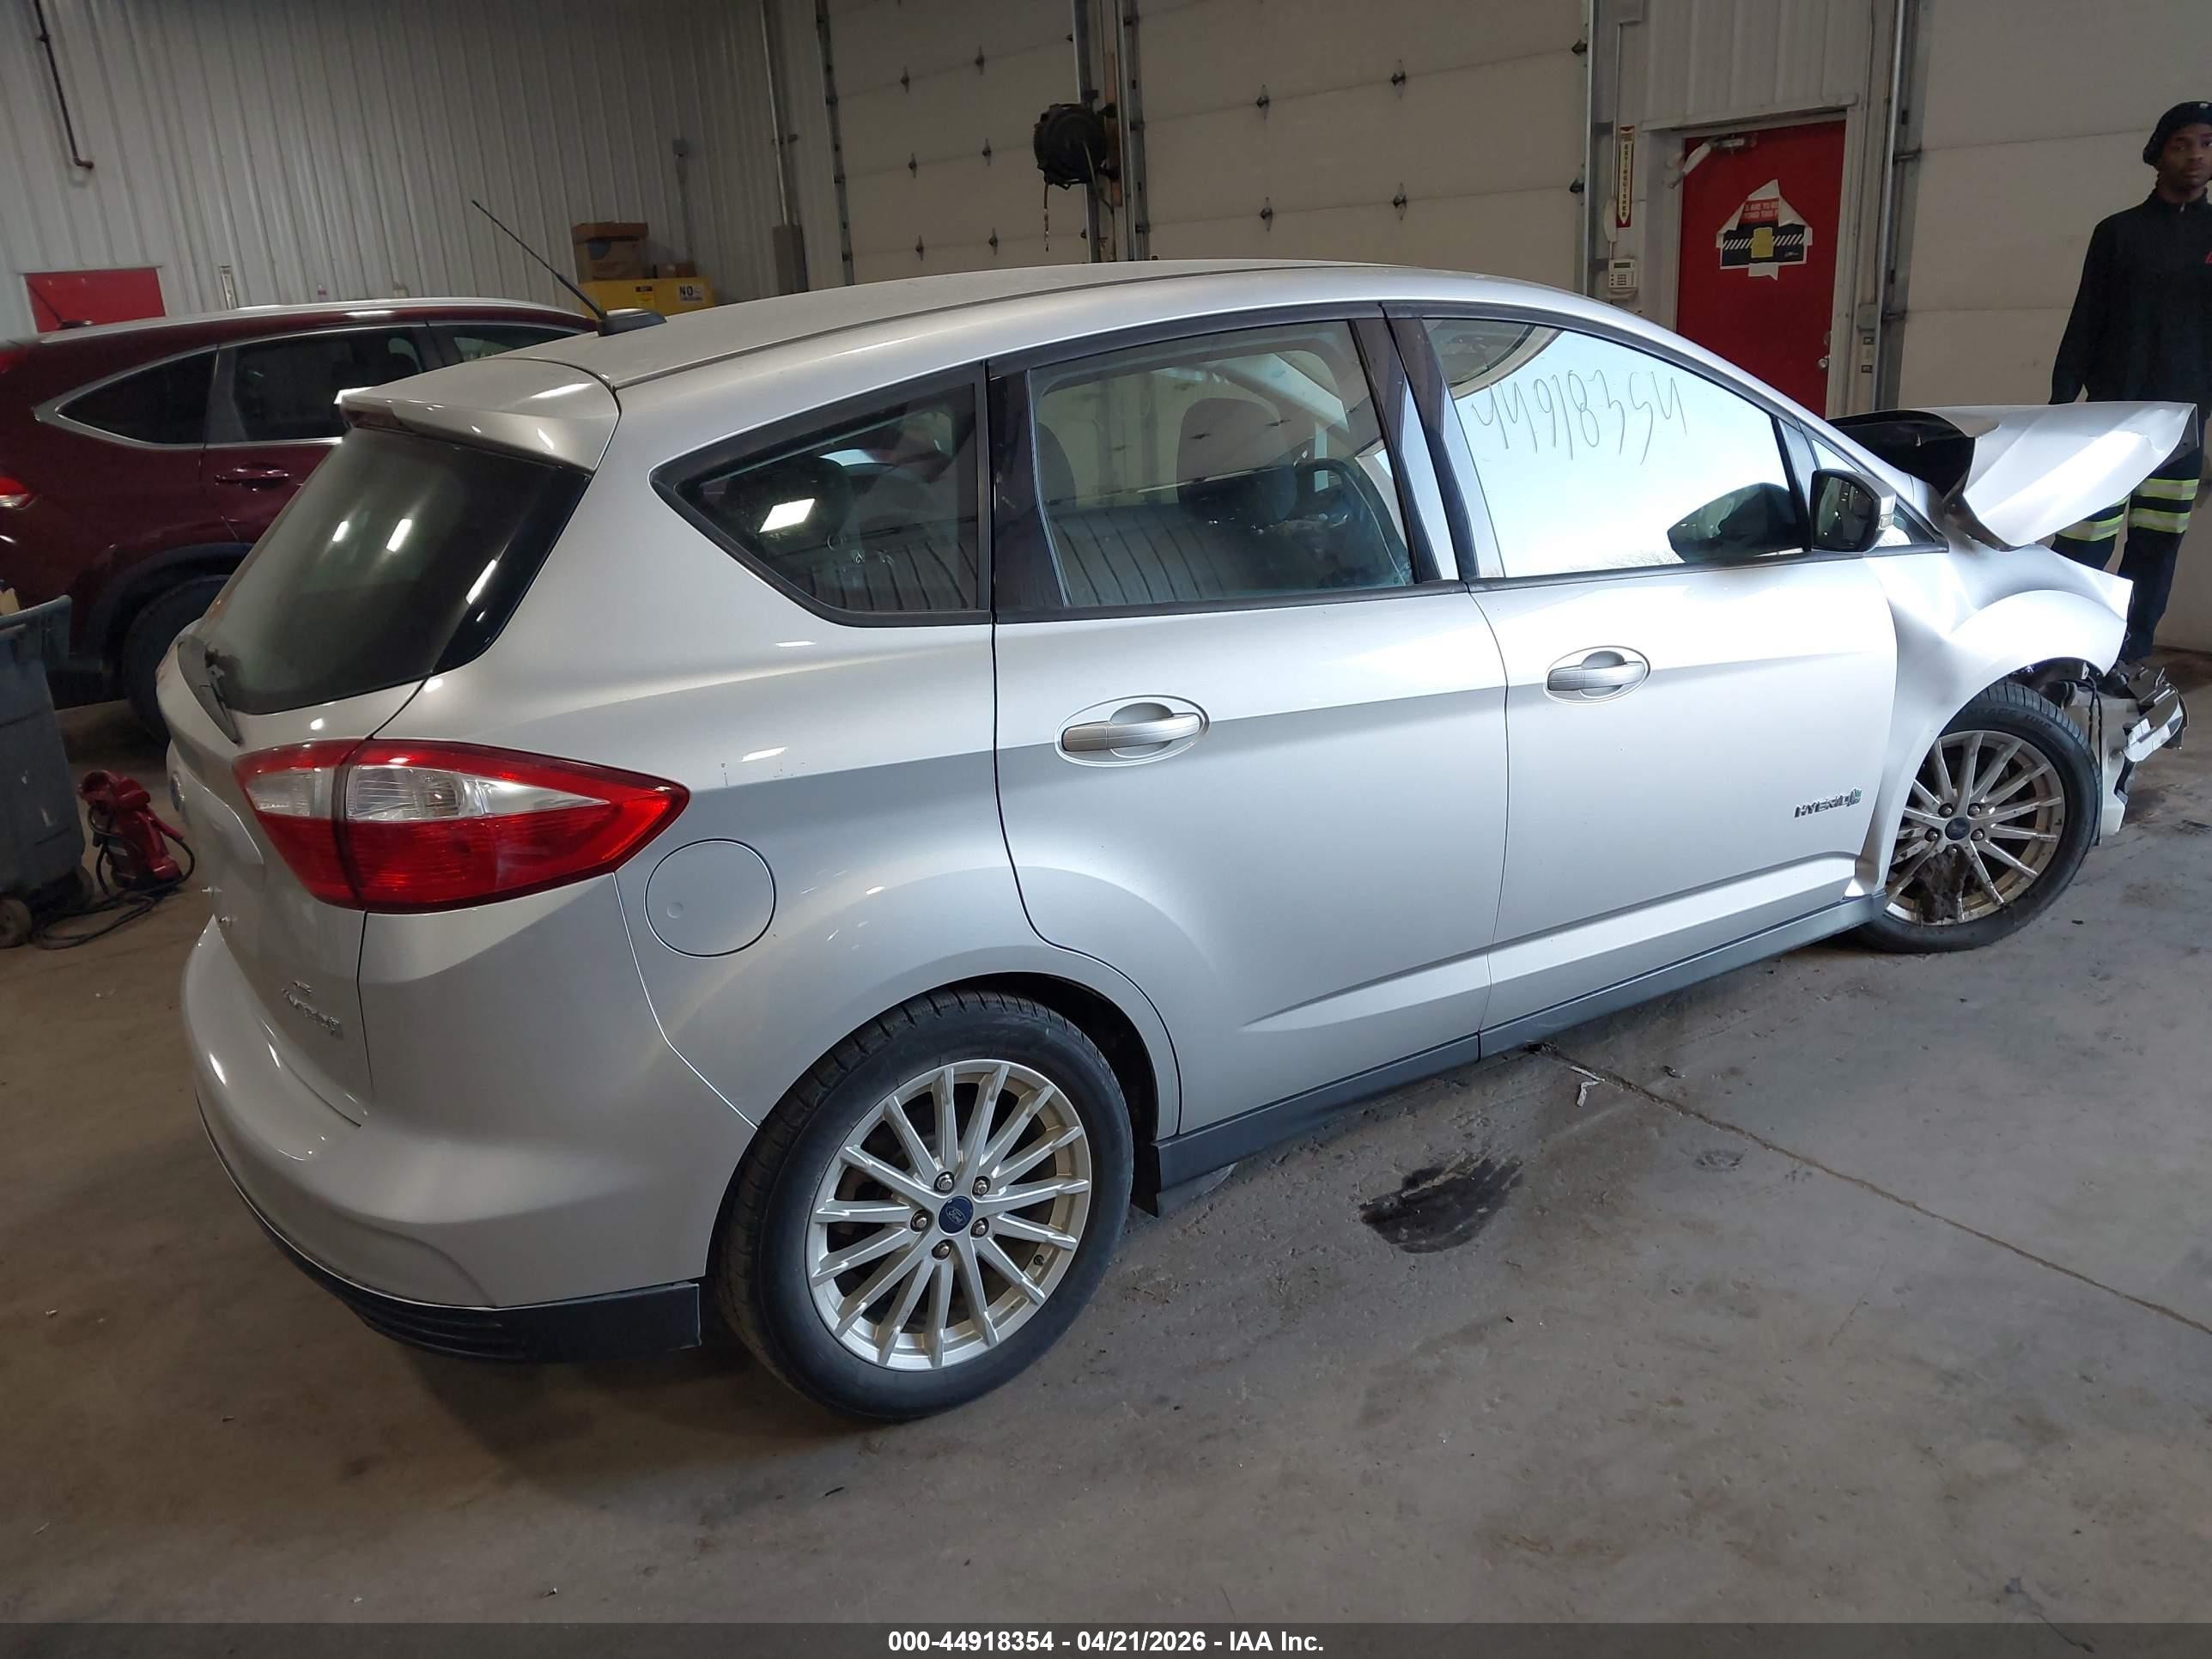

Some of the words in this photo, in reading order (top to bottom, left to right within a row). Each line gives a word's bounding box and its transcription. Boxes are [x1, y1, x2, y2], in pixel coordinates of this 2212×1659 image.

[679, 285, 694, 296] NO
[1471, 369, 1687, 465] 44918354
[1794, 793, 1850, 818] HYBRID
[948, 1207, 964, 1224] Ford
